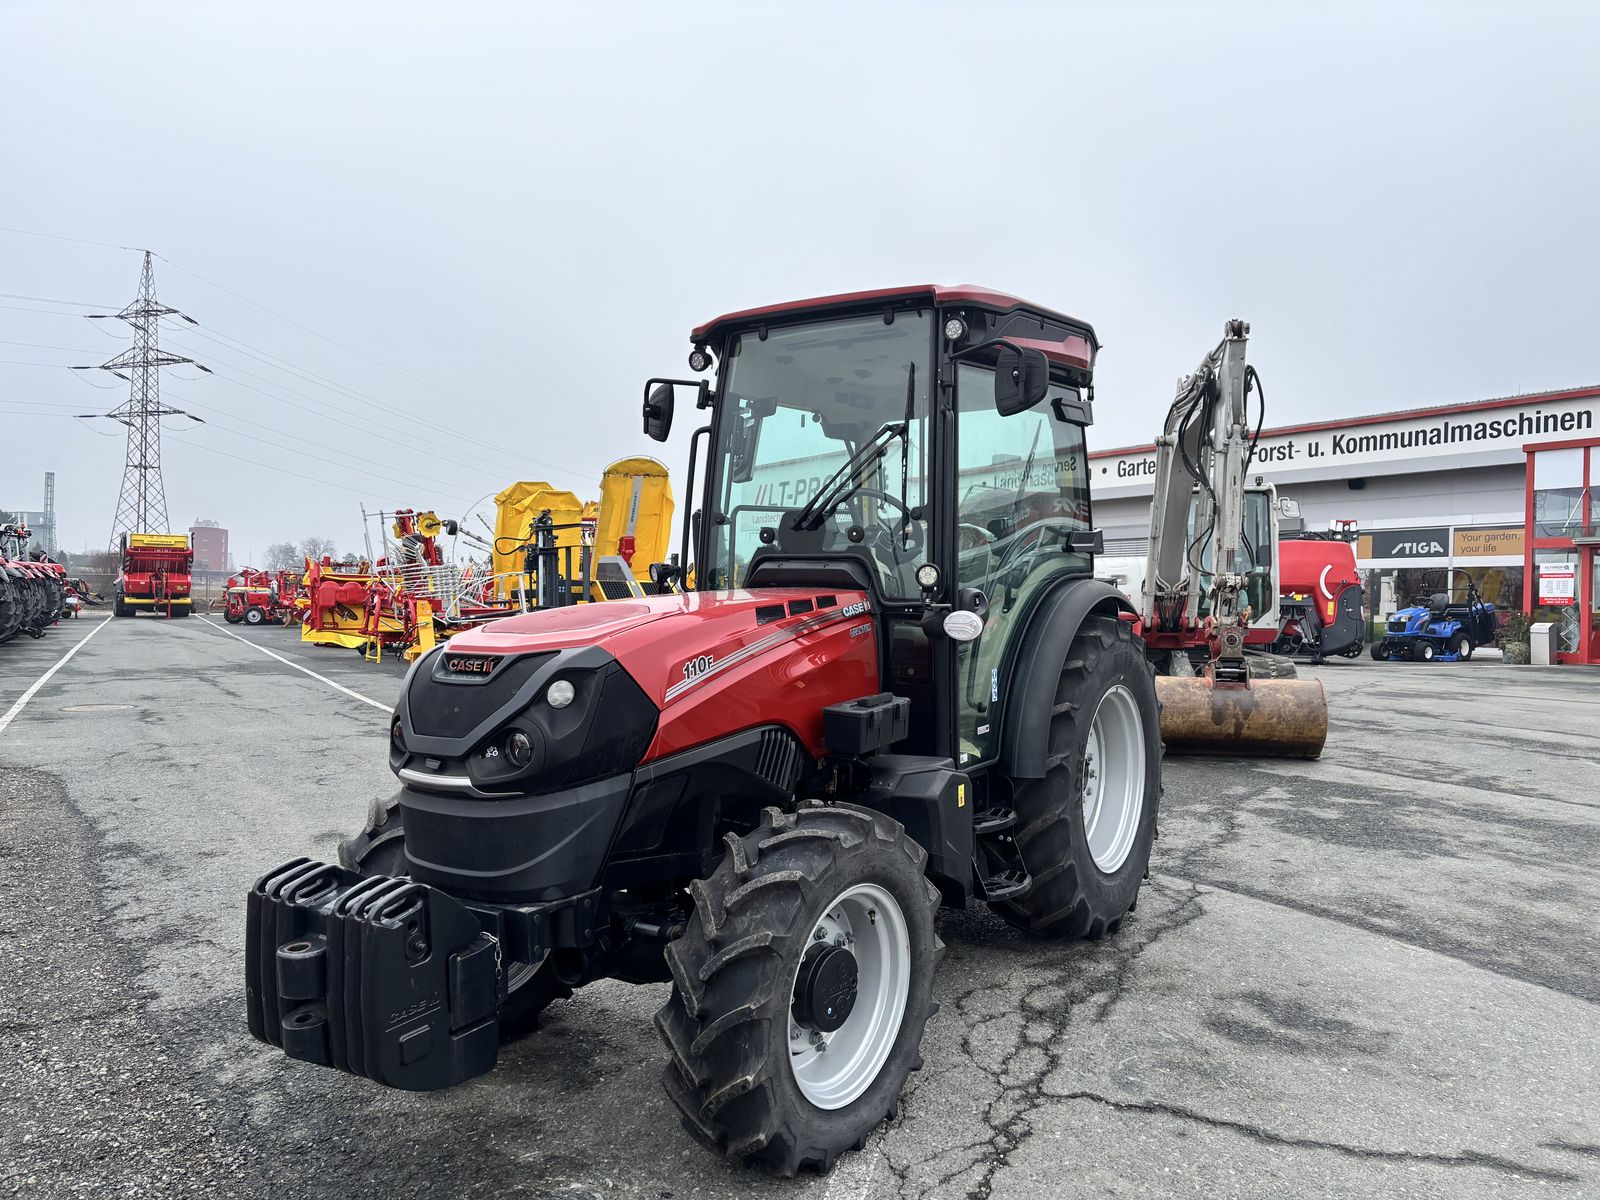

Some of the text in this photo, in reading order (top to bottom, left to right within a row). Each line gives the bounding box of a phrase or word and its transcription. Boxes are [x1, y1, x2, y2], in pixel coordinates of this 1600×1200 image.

[1117, 457, 1156, 478] Garte
[1307, 441, 1325, 458] u.
[1331, 409, 1593, 456] Kommunalmaschinen
[1461, 532, 1521, 543] Your garden,
[1391, 541, 1444, 555] STIGA
[1460, 543, 1497, 555] your life
[842, 602, 864, 617] CASE
[449, 659, 482, 672] CASE
